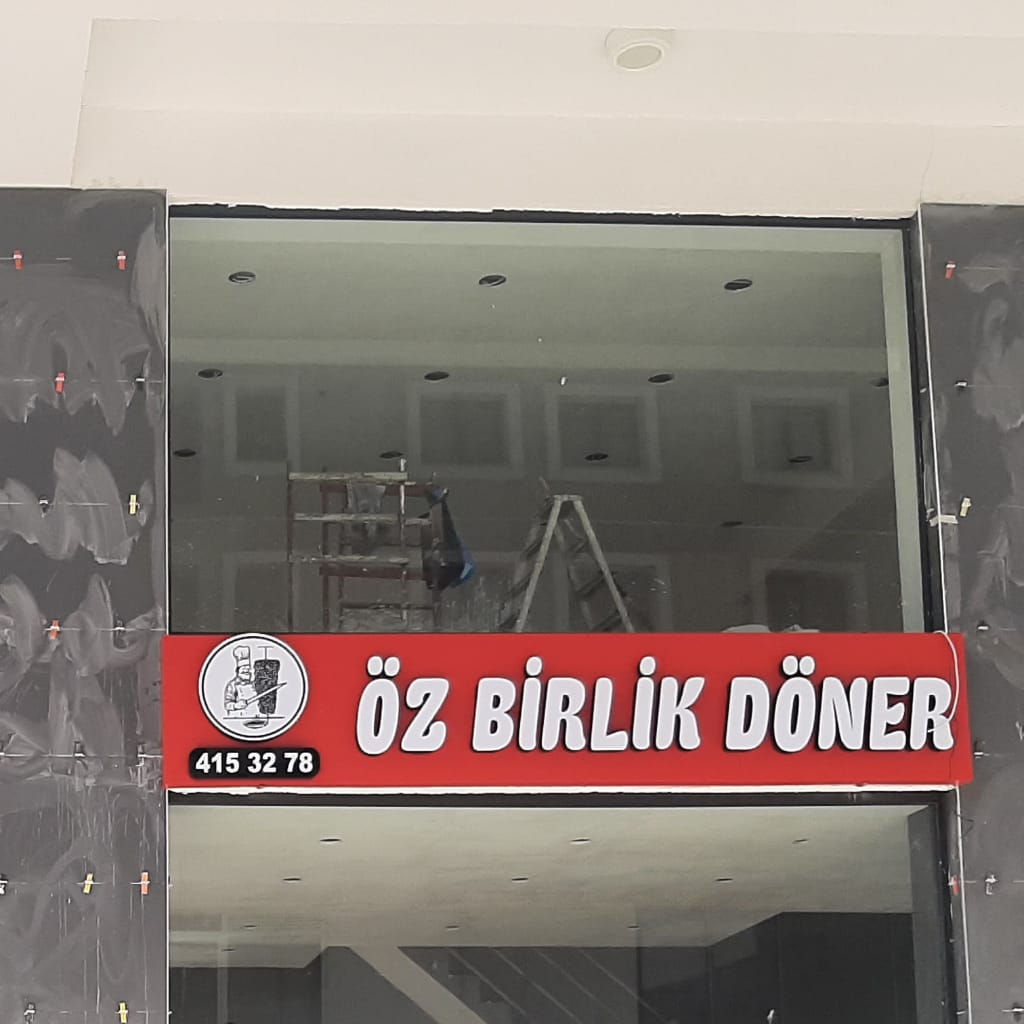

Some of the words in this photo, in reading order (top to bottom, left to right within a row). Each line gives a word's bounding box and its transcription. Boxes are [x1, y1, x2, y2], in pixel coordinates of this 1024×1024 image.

[357, 656, 449, 754] ÖZ
[473, 656, 702, 752] BİRLİK
[725, 656, 954, 752] DÖNER
[196, 752, 239, 773] 415
[247, 752, 277, 773] 32
[285, 752, 313, 773] 78
